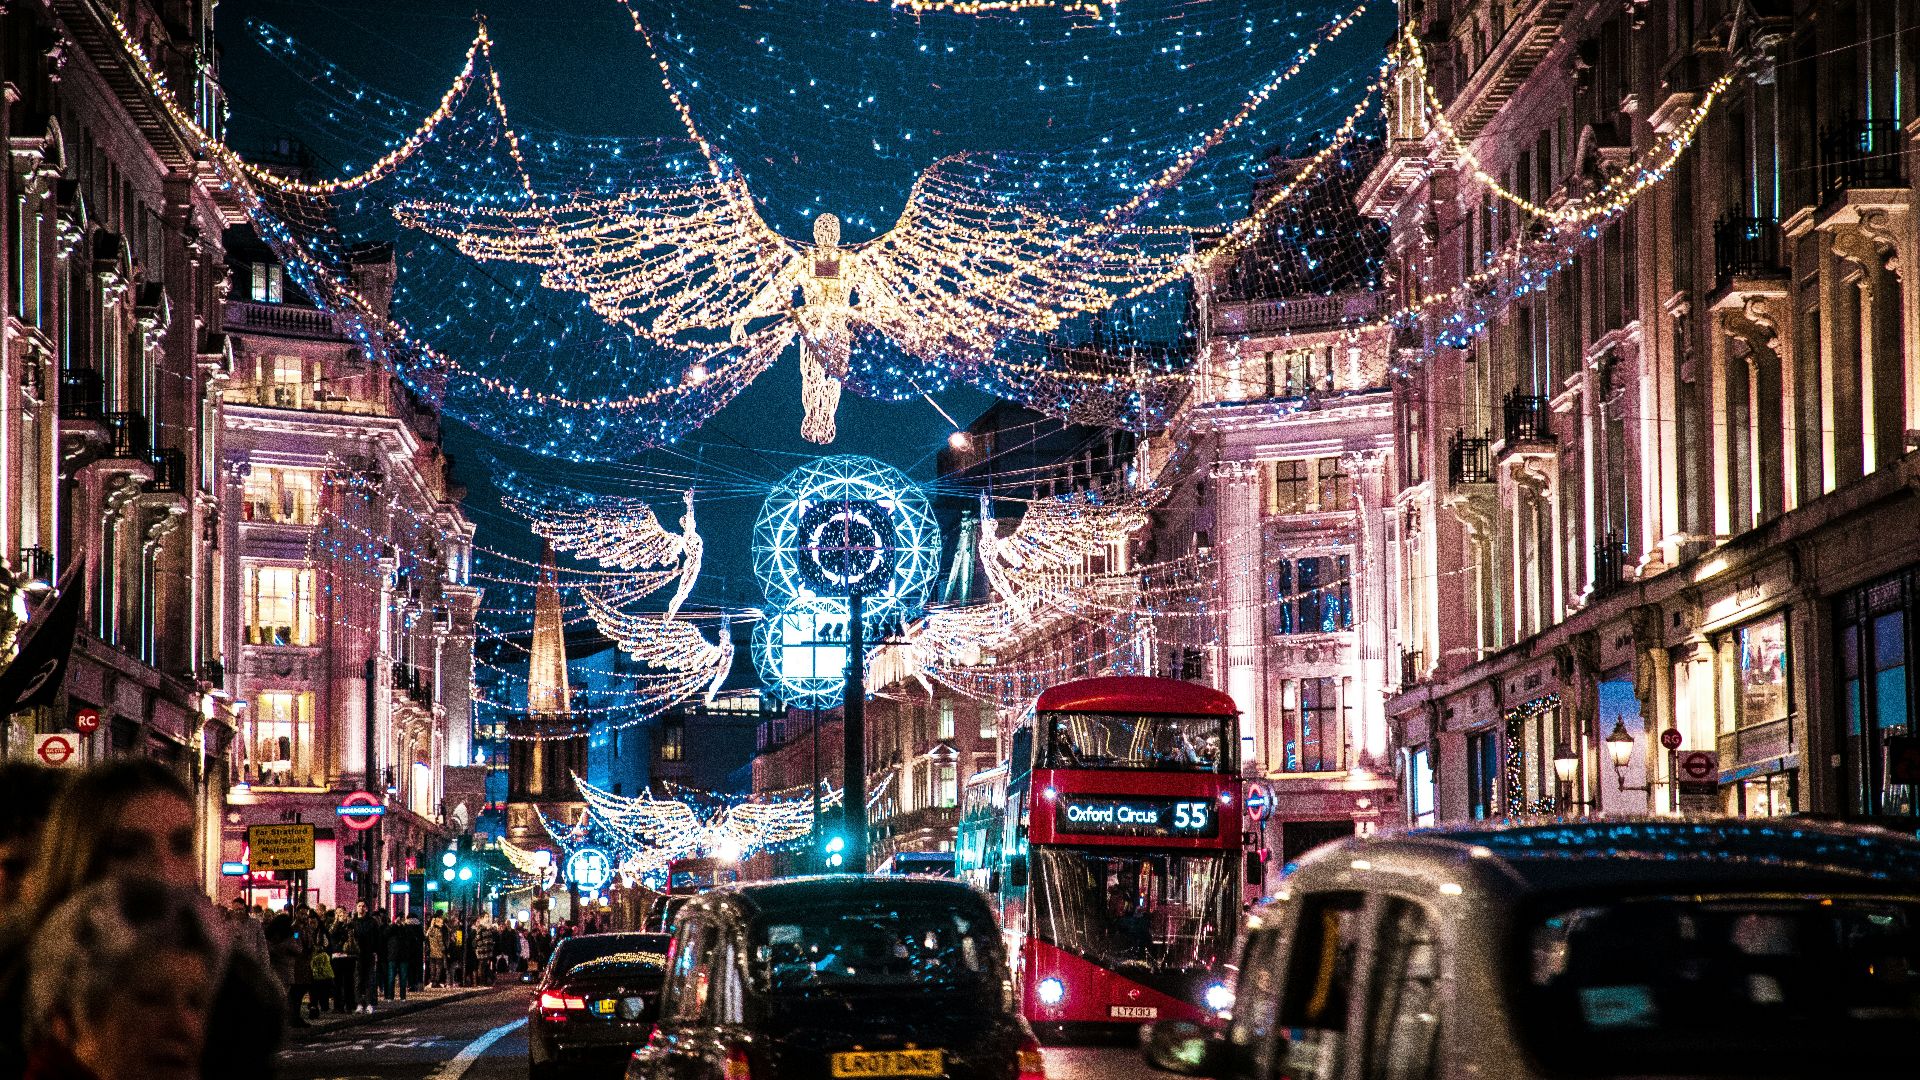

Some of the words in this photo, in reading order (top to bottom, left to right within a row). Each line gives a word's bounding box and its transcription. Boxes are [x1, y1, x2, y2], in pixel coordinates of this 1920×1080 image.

[79, 716, 96, 726] RC
[1068, 805, 1112, 822] Oxford
[1117, 806, 1158, 823] Circus
[1174, 803, 1206, 828] 55
